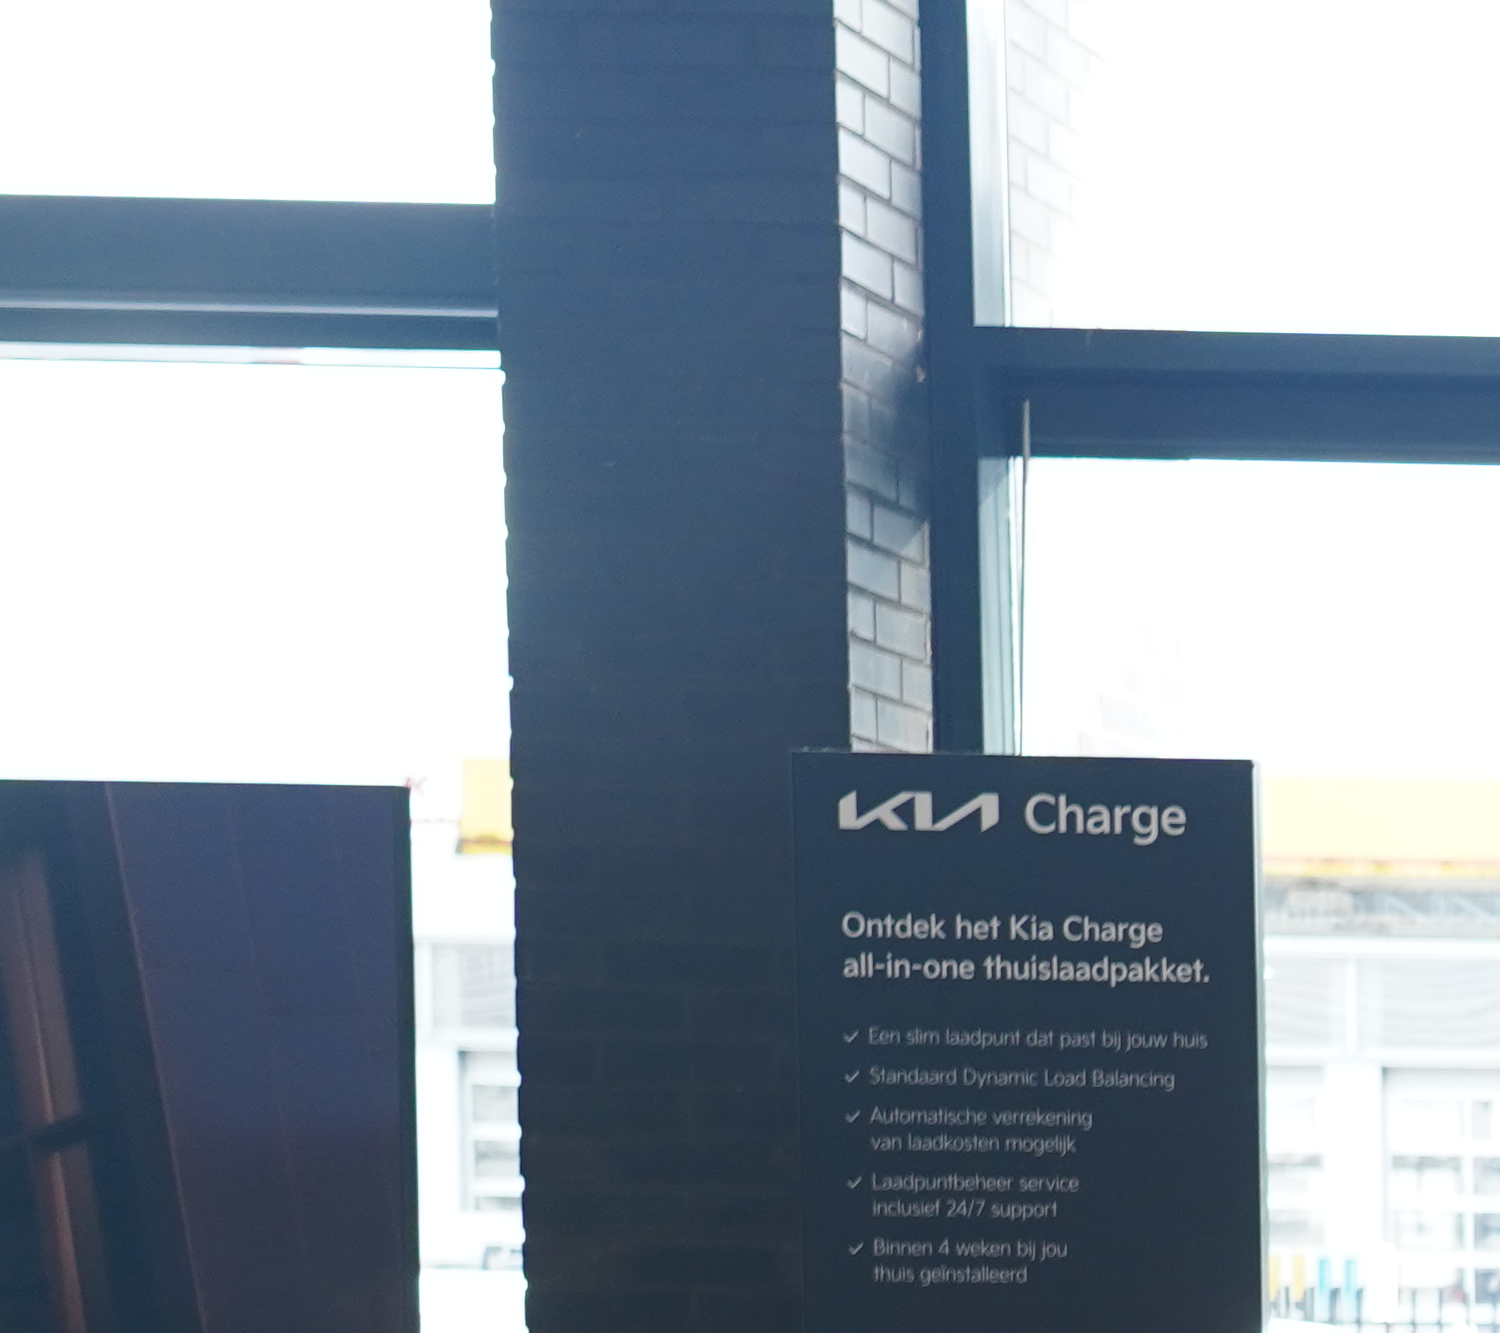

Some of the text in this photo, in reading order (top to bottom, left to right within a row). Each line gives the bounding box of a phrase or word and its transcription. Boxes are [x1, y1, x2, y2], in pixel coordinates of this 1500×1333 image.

[838, 789, 1188, 846] KIA Charge
[842, 911, 1163, 949] Ontdek het Kia Charge
[843, 952, 1210, 988] all-in-one thuislaadpakket.
[869, 1026, 1208, 1053] Een slim laadpunt dat past bij jouw huis
[869, 1066, 1175, 1092] Standaard Dynamic Load Balancing
[870, 1106, 1093, 1131] Automatische verrekening
[870, 1133, 1076, 1157] van laadkosten mogelijk
[871, 1172, 1080, 1196] Laadpuntbeheer service
[872, 1198, 1058, 1222] inclusief 24/7 support
[873, 1237, 1068, 1261] Binnen 4 weken bij jou
[874, 1264, 1028, 1287] thuis geïnstalleerd
